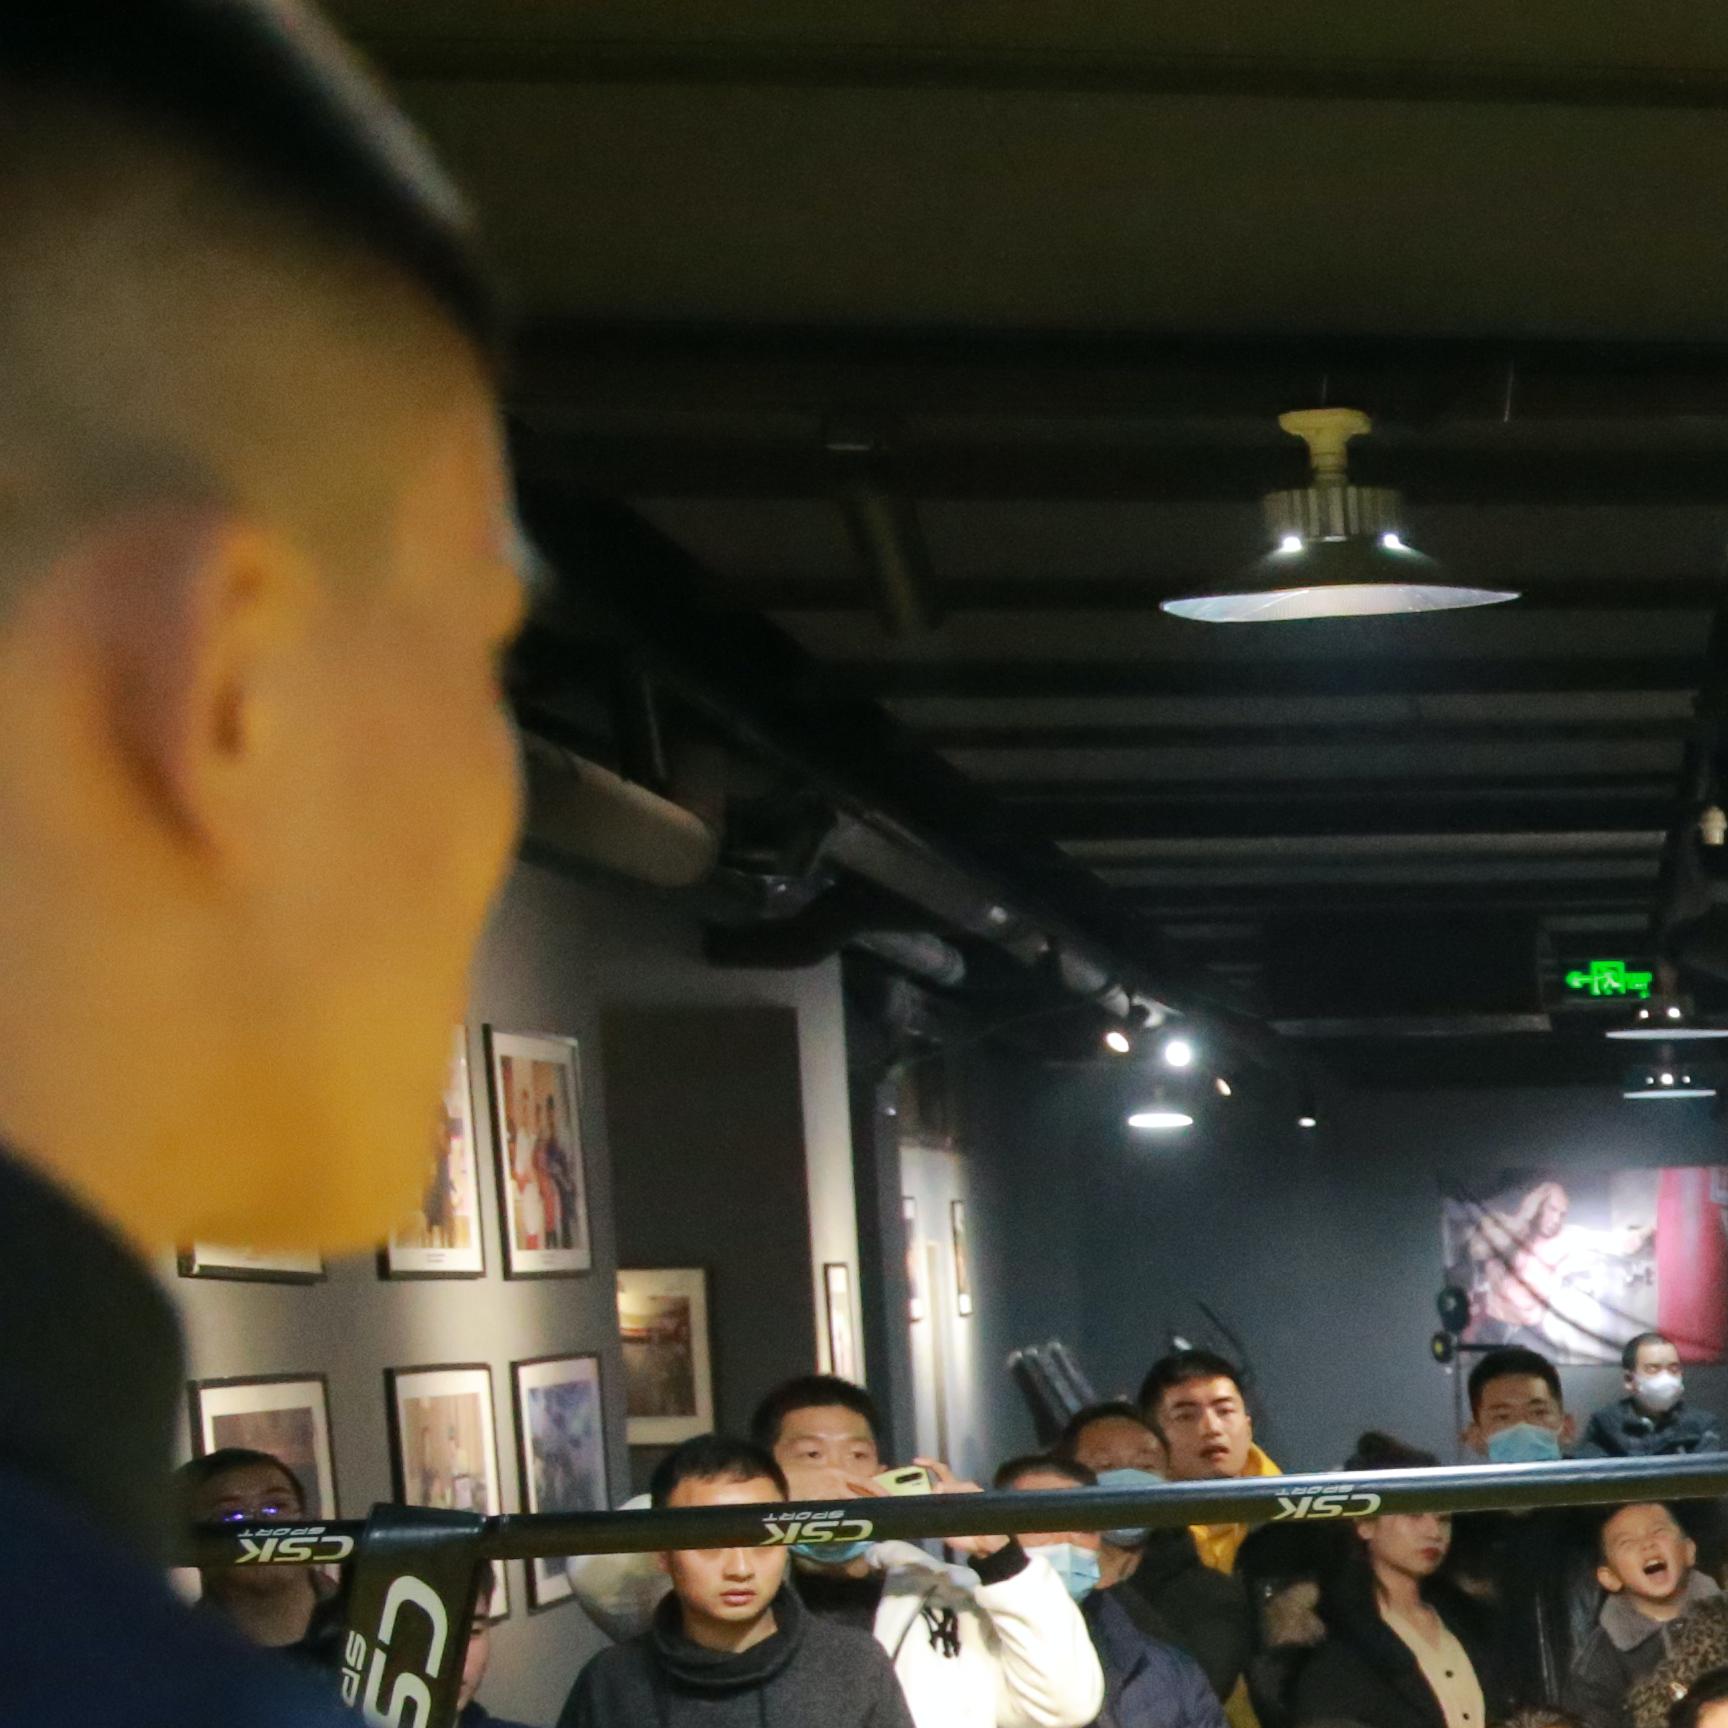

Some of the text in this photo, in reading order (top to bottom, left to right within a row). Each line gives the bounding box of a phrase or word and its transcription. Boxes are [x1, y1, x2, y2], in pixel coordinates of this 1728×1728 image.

[1273, 1493, 1382, 1520] CSK
[760, 1519, 873, 1545] CSK
[235, 1536, 354, 1564] CSK
